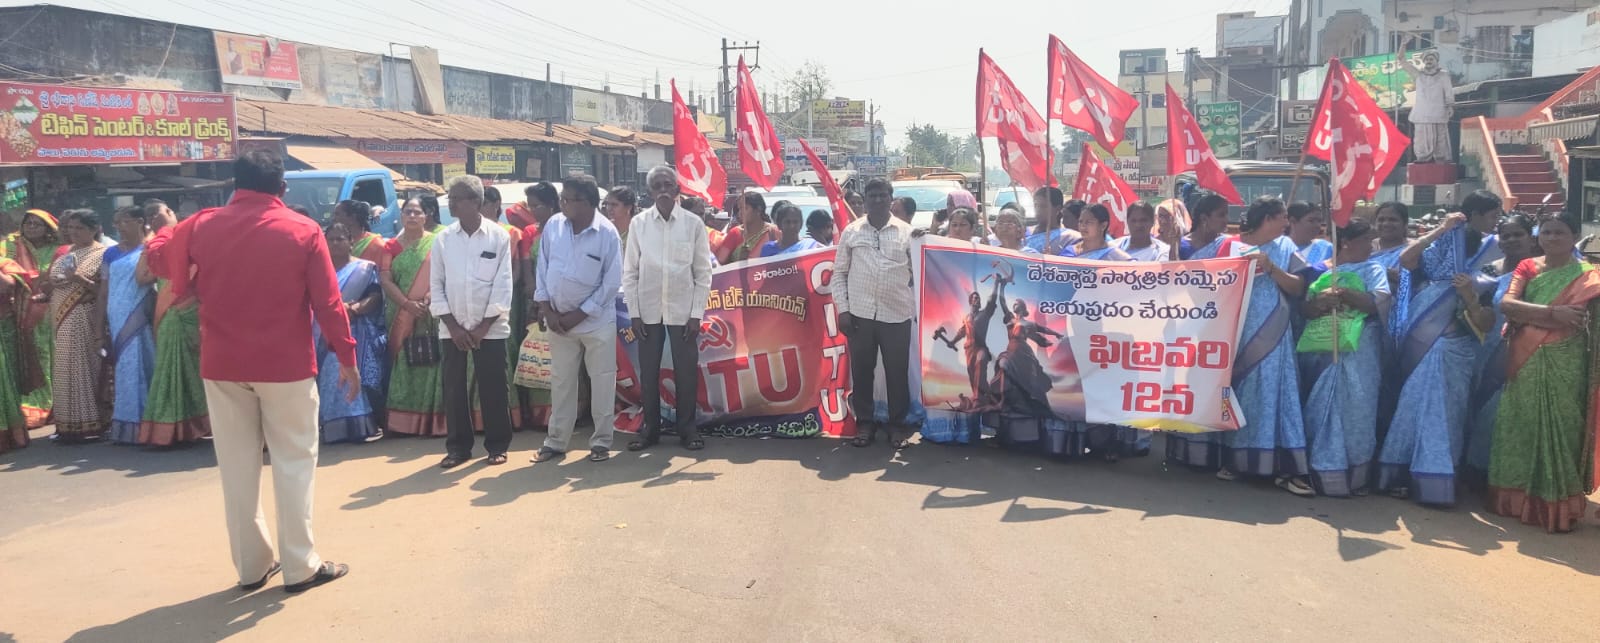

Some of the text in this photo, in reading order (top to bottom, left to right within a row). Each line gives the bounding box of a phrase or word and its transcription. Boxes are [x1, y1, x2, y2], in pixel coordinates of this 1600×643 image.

[41, 112, 232, 142] టిఫిన్ సెంటర్ & కూల్ డ్రింక్స్
[753, 266, 798, 281] పోరాటం!!
[1027, 263, 1238, 292] దేశవ్యాప్త సార్వత్రిక సమ్మెను
[722, 286, 744, 311] ట్రేడ్
[746, 290, 808, 321] యూనియన్స్
[1039, 298, 1219, 321] జయప్రదం చేయండి
[811, 261, 847, 423] CITU
[1089, 334, 1230, 372] ఫిబ్రవరి
[1120, 381, 1195, 416] 12న
